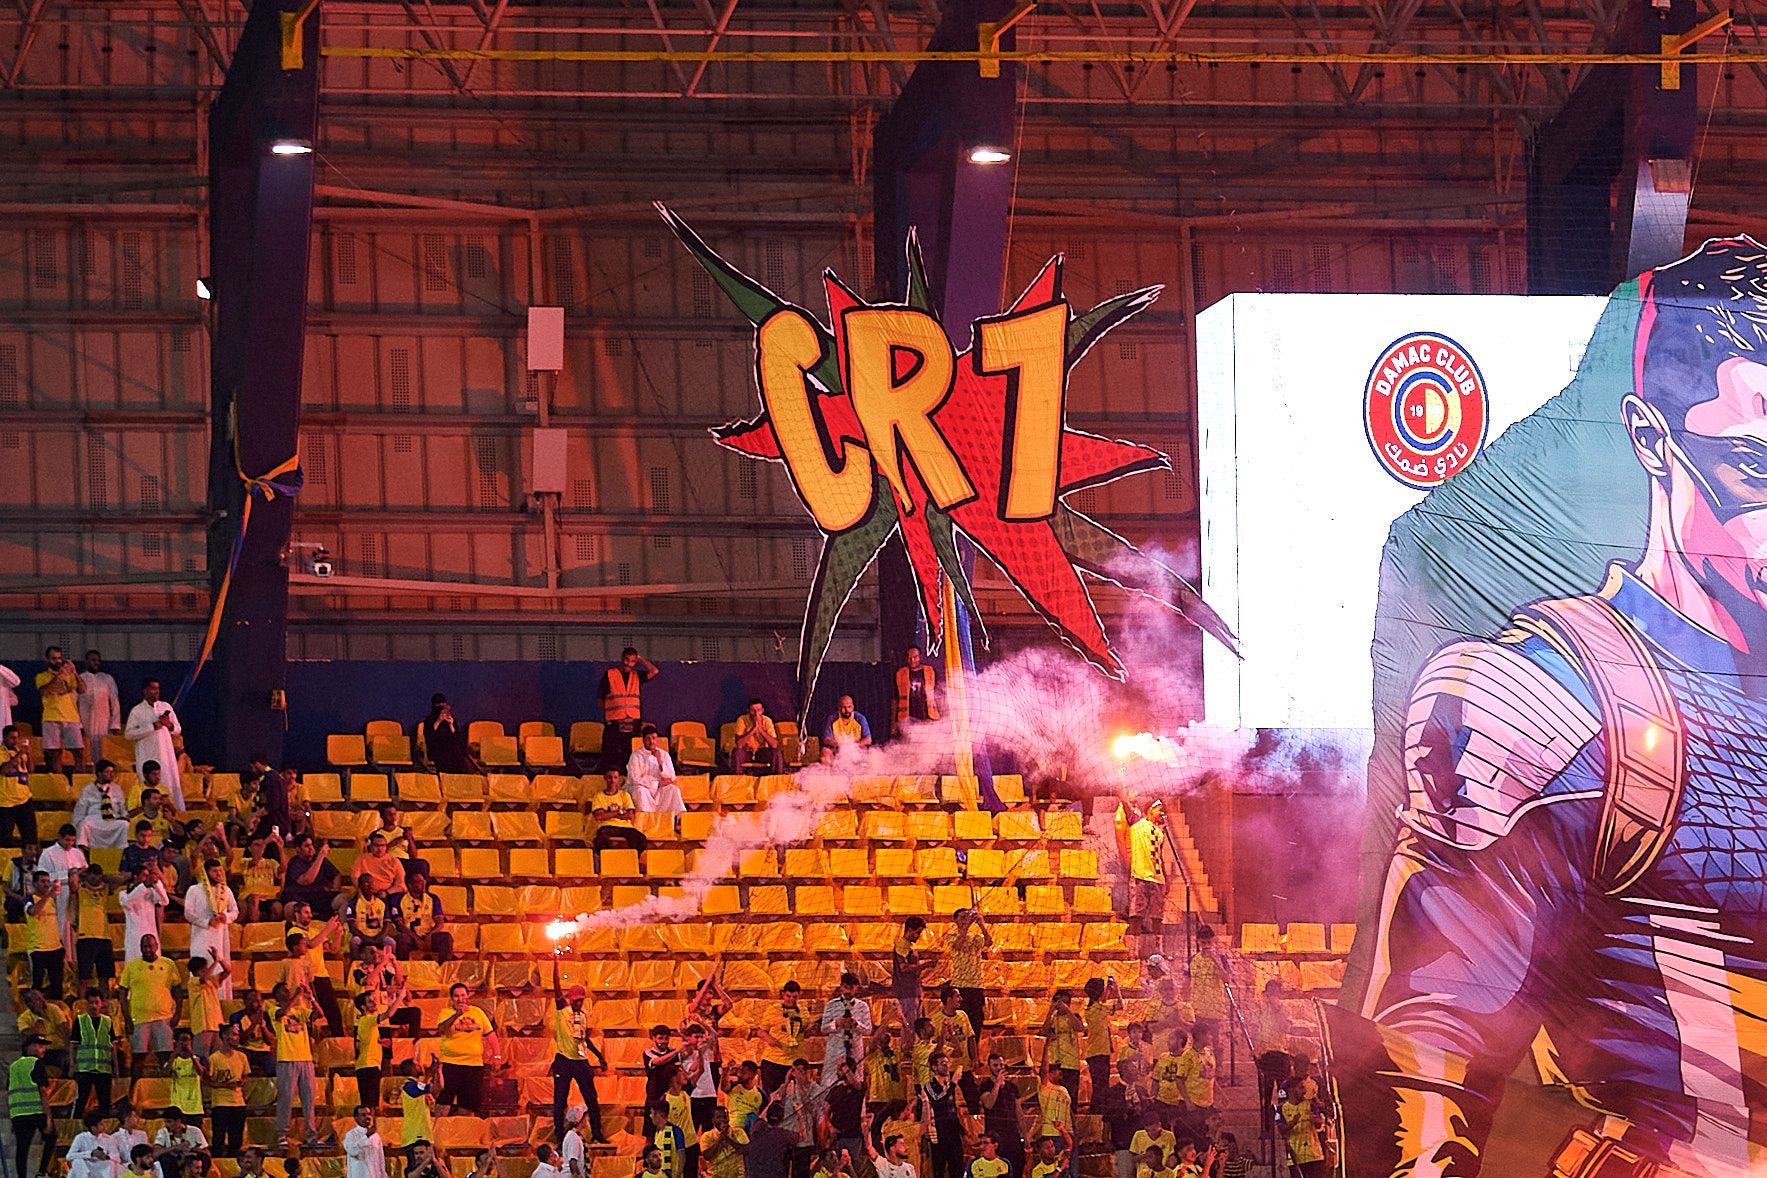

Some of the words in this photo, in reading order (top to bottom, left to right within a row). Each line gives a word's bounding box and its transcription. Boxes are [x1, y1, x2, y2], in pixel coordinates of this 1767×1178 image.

[1375, 343, 1431, 396] DAMAC
[1435, 347, 1476, 396] CLUB
[1410, 404, 1424, 417] 19
[1434, 442, 1469, 479] نادي
